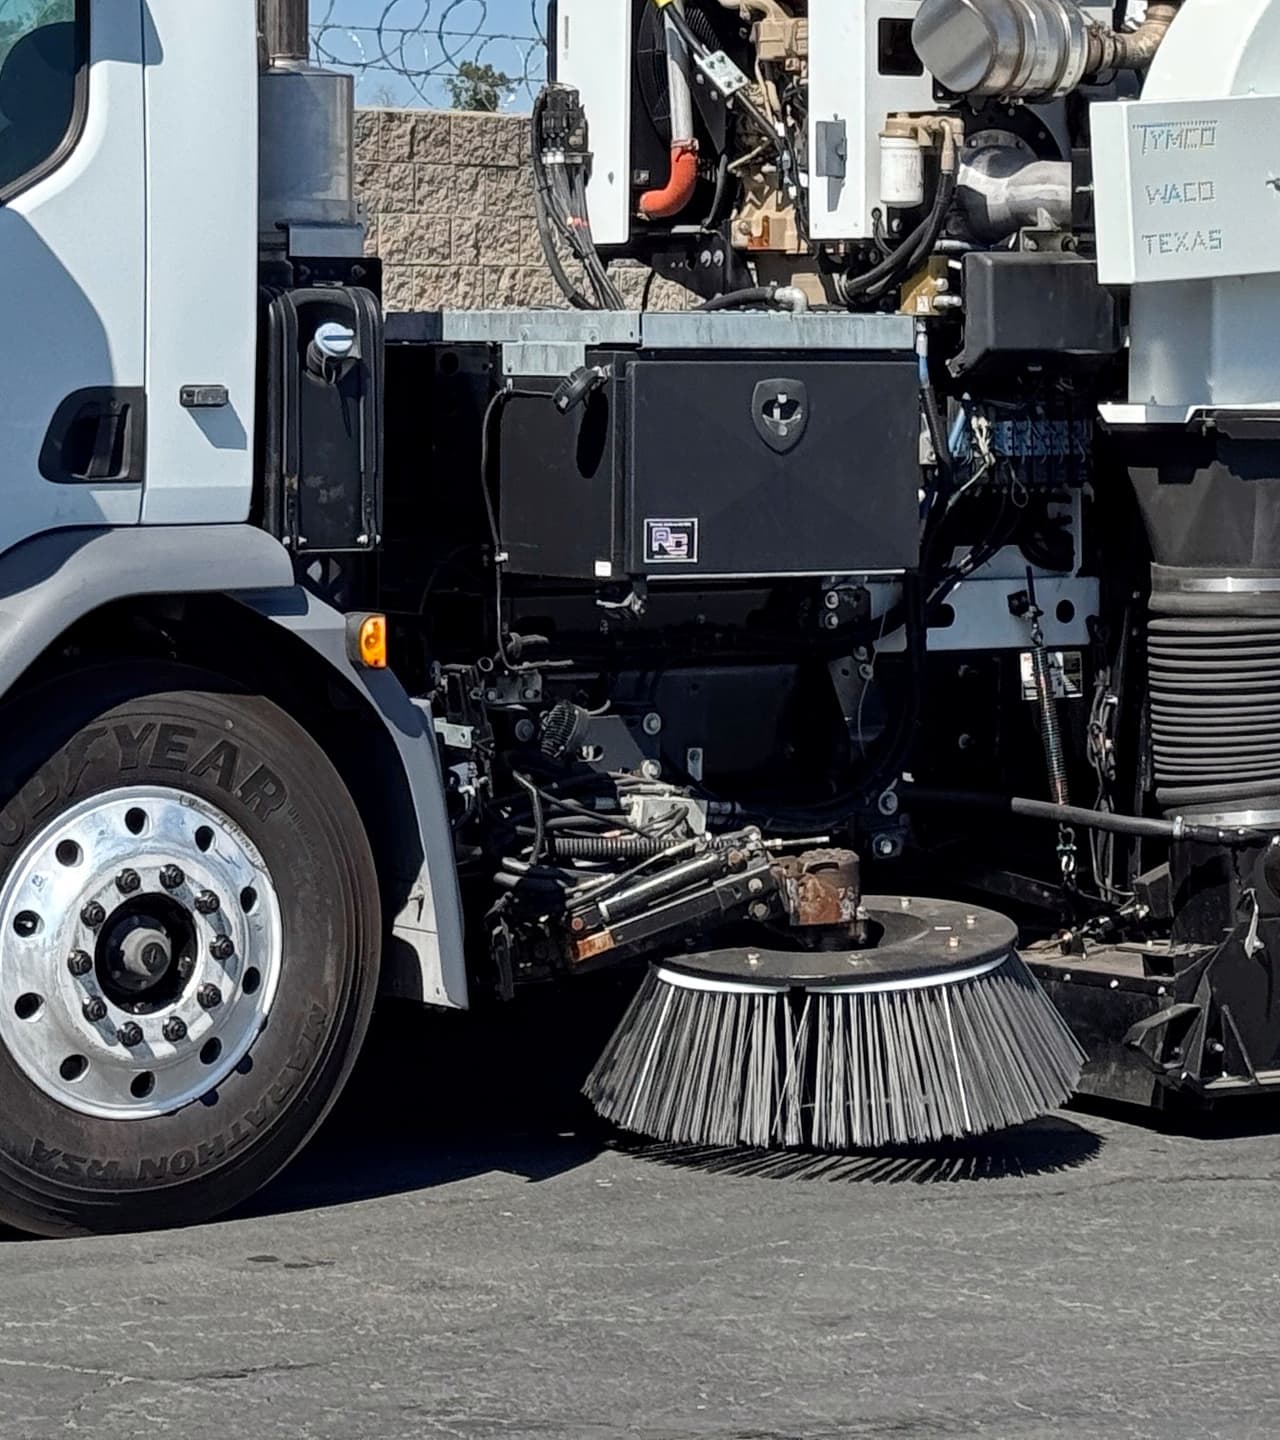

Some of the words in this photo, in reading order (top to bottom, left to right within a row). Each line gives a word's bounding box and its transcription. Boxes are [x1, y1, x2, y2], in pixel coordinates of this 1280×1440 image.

[1132, 120, 1218, 155] TYMCO
[1145, 181, 1215, 205] WACO
[1142, 229, 1221, 255] TEXAS
